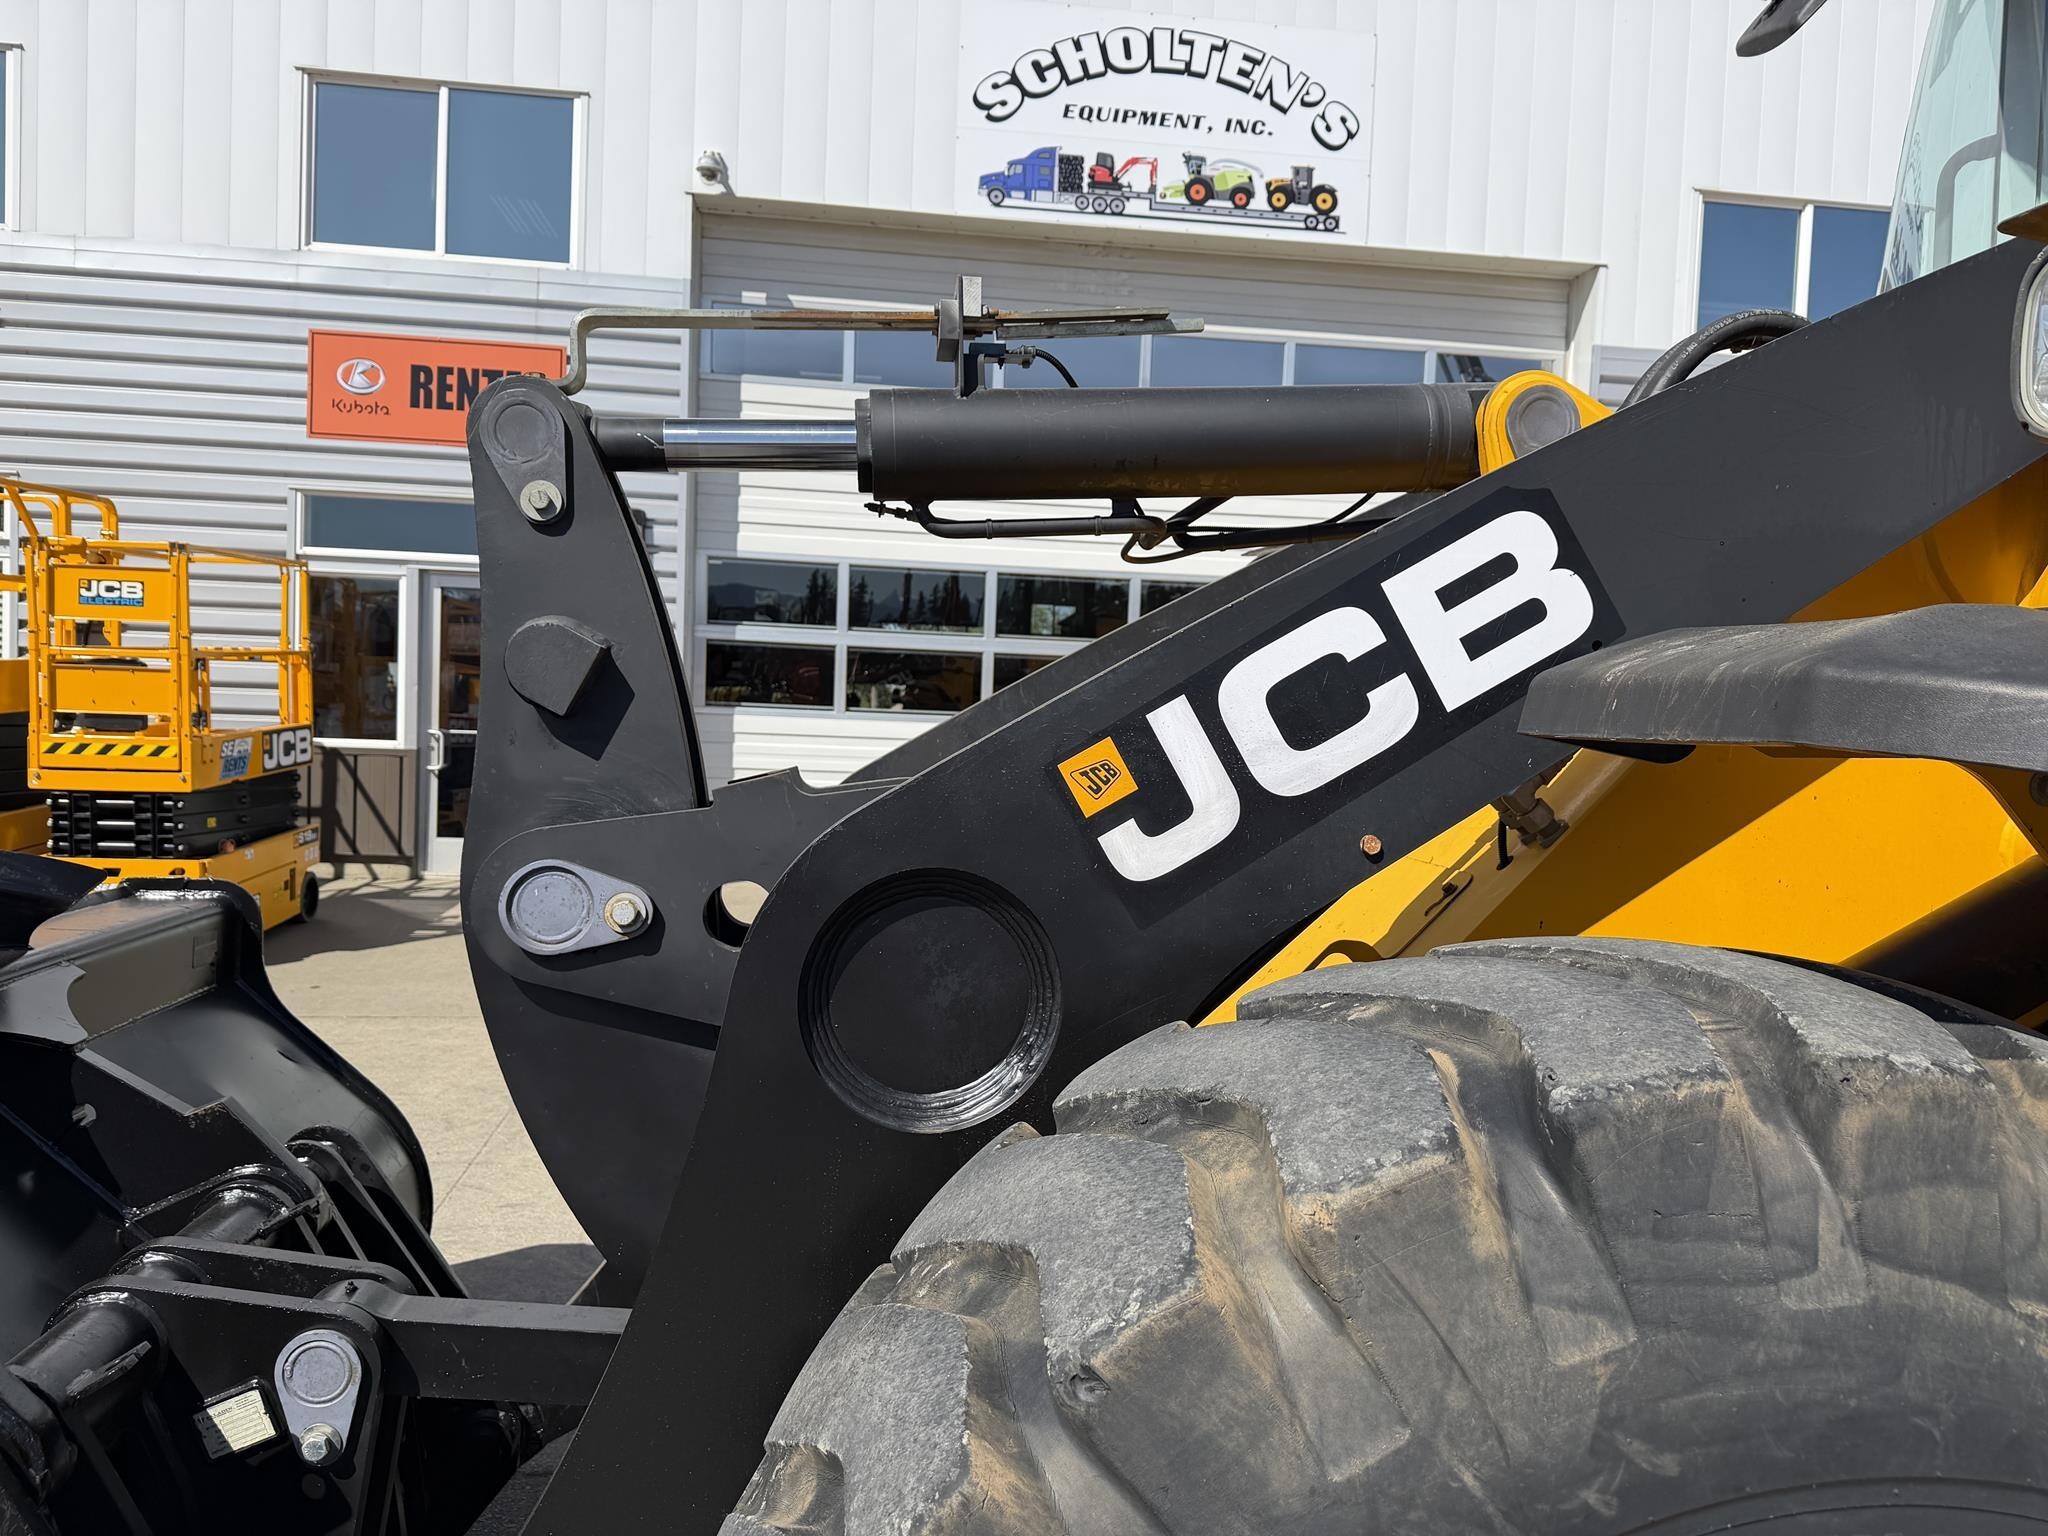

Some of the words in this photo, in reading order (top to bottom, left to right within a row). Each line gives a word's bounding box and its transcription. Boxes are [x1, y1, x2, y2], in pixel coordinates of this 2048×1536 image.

[973, 26, 1360, 150] SCHOLTEN'S
[1062, 103, 1214, 134] EQUIPMENT,
[1225, 118, 1274, 136] INC.
[332, 399, 390, 415] Kubota
[80, 579, 143, 599] JCB
[80, 596, 144, 606] ELECTRIC
[1097, 510, 1594, 882] JCB
[263, 728, 312, 770] JCB
[1079, 762, 1118, 795] JCB
